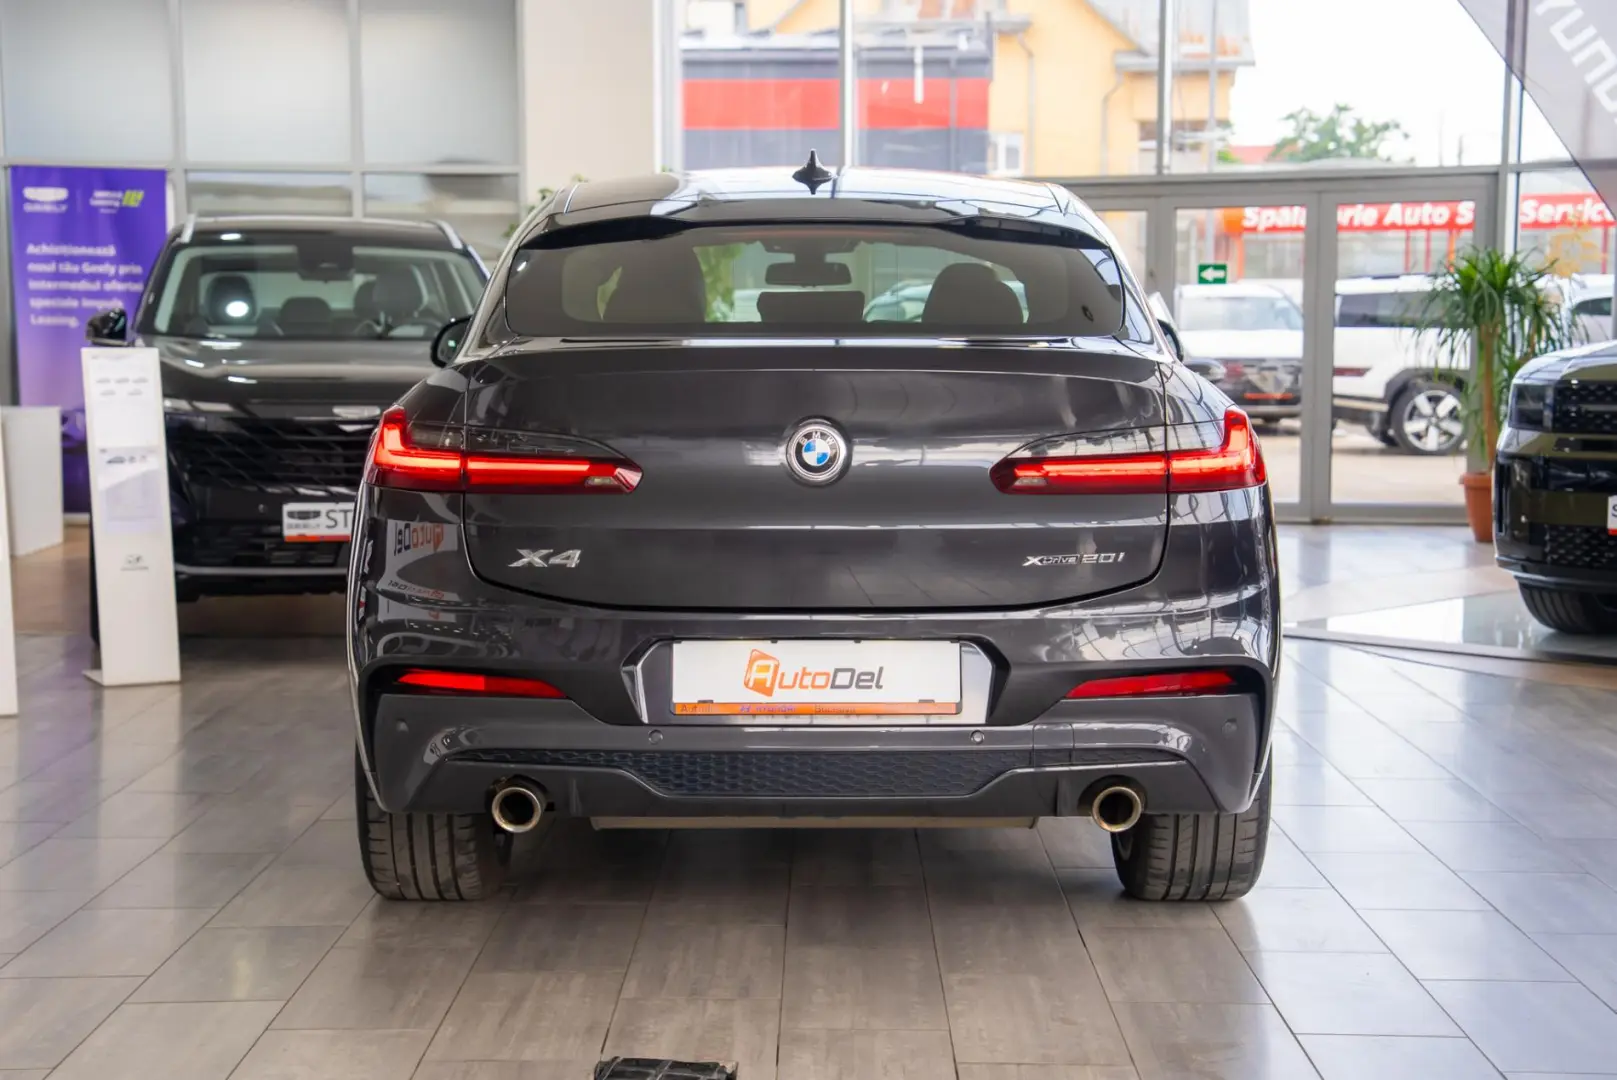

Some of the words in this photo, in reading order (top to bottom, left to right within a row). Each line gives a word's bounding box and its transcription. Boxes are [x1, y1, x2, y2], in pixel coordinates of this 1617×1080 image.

[1383, 202, 1450, 226] Auto
[799, 430, 835, 446] BMW
[508, 548, 582, 568] X4
[745, 657, 884, 690] AutoDel
